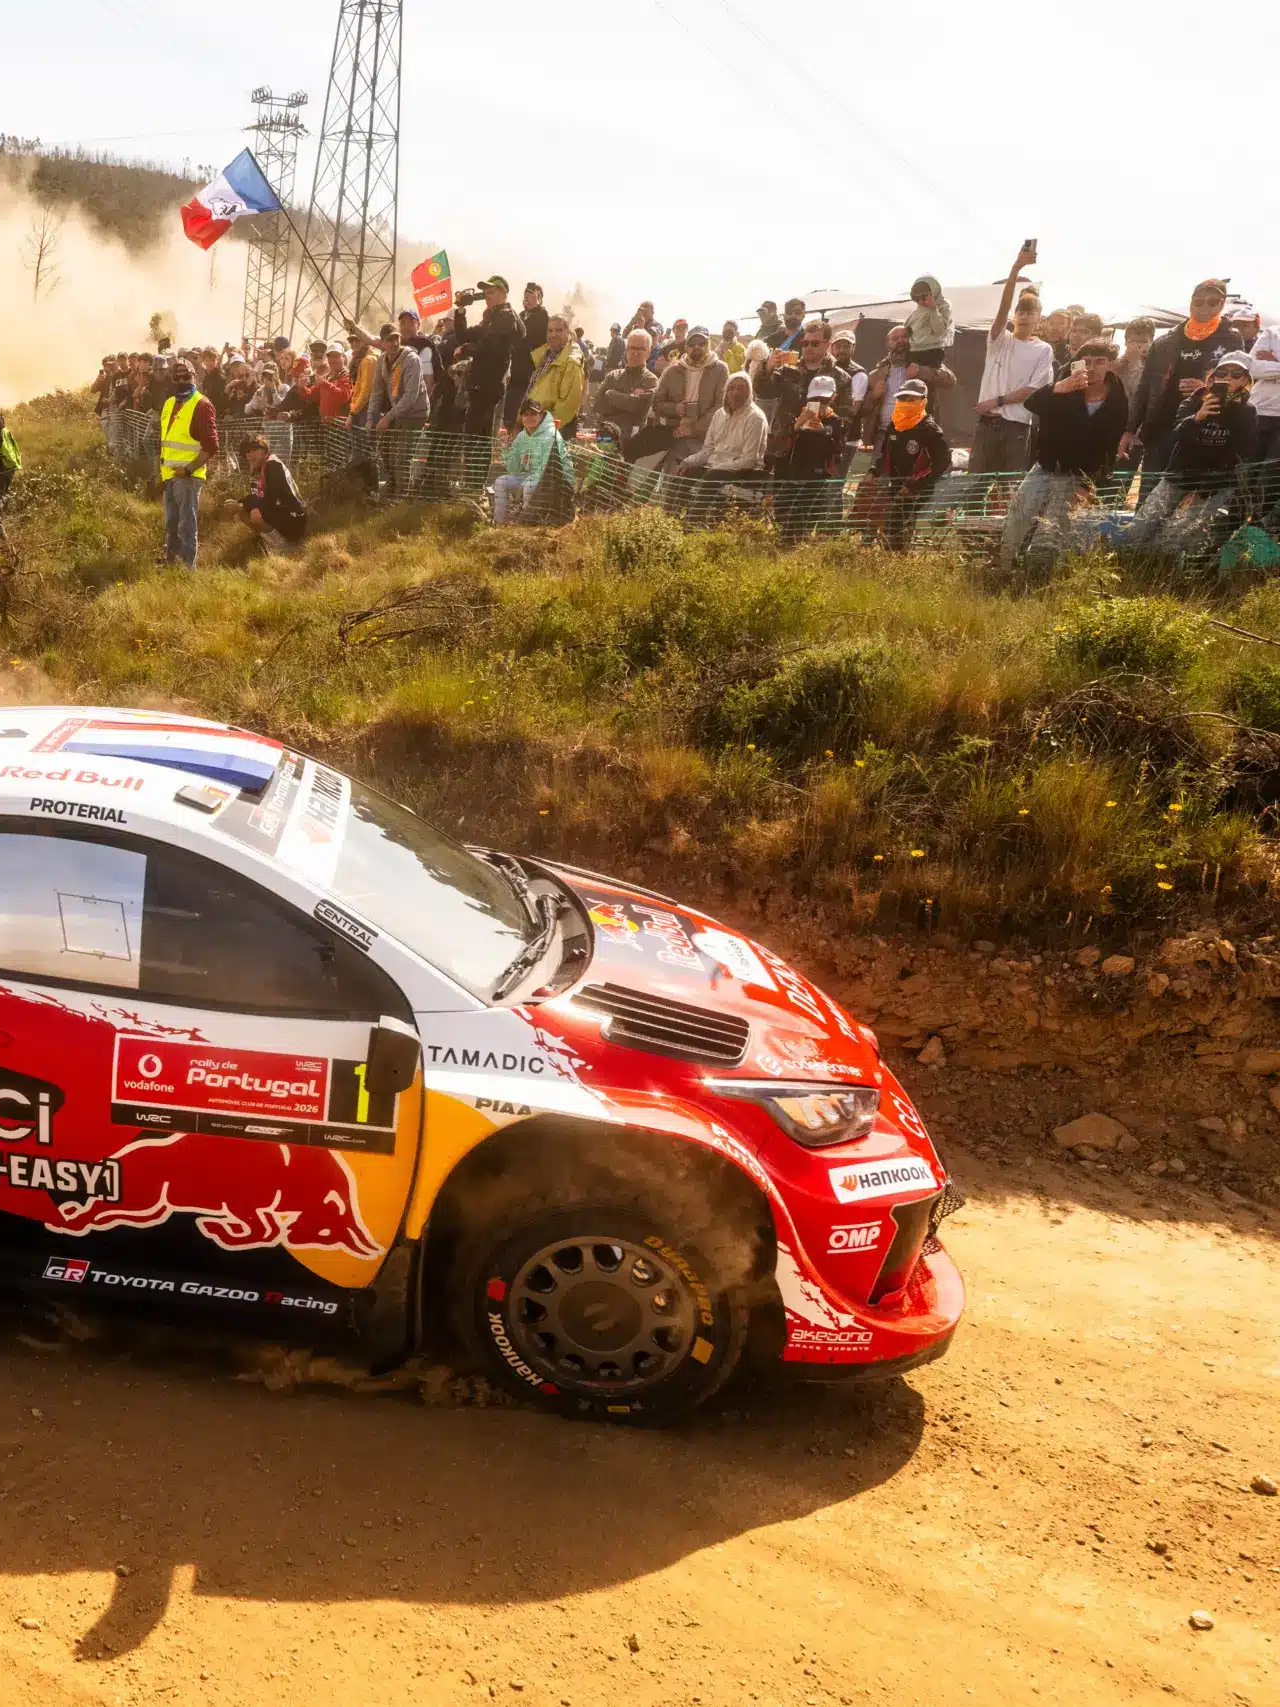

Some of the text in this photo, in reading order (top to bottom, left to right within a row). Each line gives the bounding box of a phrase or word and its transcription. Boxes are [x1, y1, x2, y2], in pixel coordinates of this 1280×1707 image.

[74, 770, 145, 791] Bull
[30, 797, 128, 824] PROTERIAL
[315, 902, 373, 946] CENTRAL
[189, 1058, 238, 1070] rally de
[295, 1060, 322, 1069] WRC
[428, 1045, 545, 1074] TAMADIC
[123, 1080, 175, 1093] vodafone
[186, 1068, 320, 1098] Portugal
[354, 1064, 370, 1123] 1
[264, 1103, 292, 1111] PORTUGAL
[294, 1103, 319, 1113] 2026
[474, 1097, 533, 1115] PIAA
[136, 1112, 171, 1124] WRC
[829, 1226, 881, 1248] OMP
[45, 1266, 339, 1315] GR TOYOTA GAZOO Racing
[791, 1329, 874, 1342] akebono
